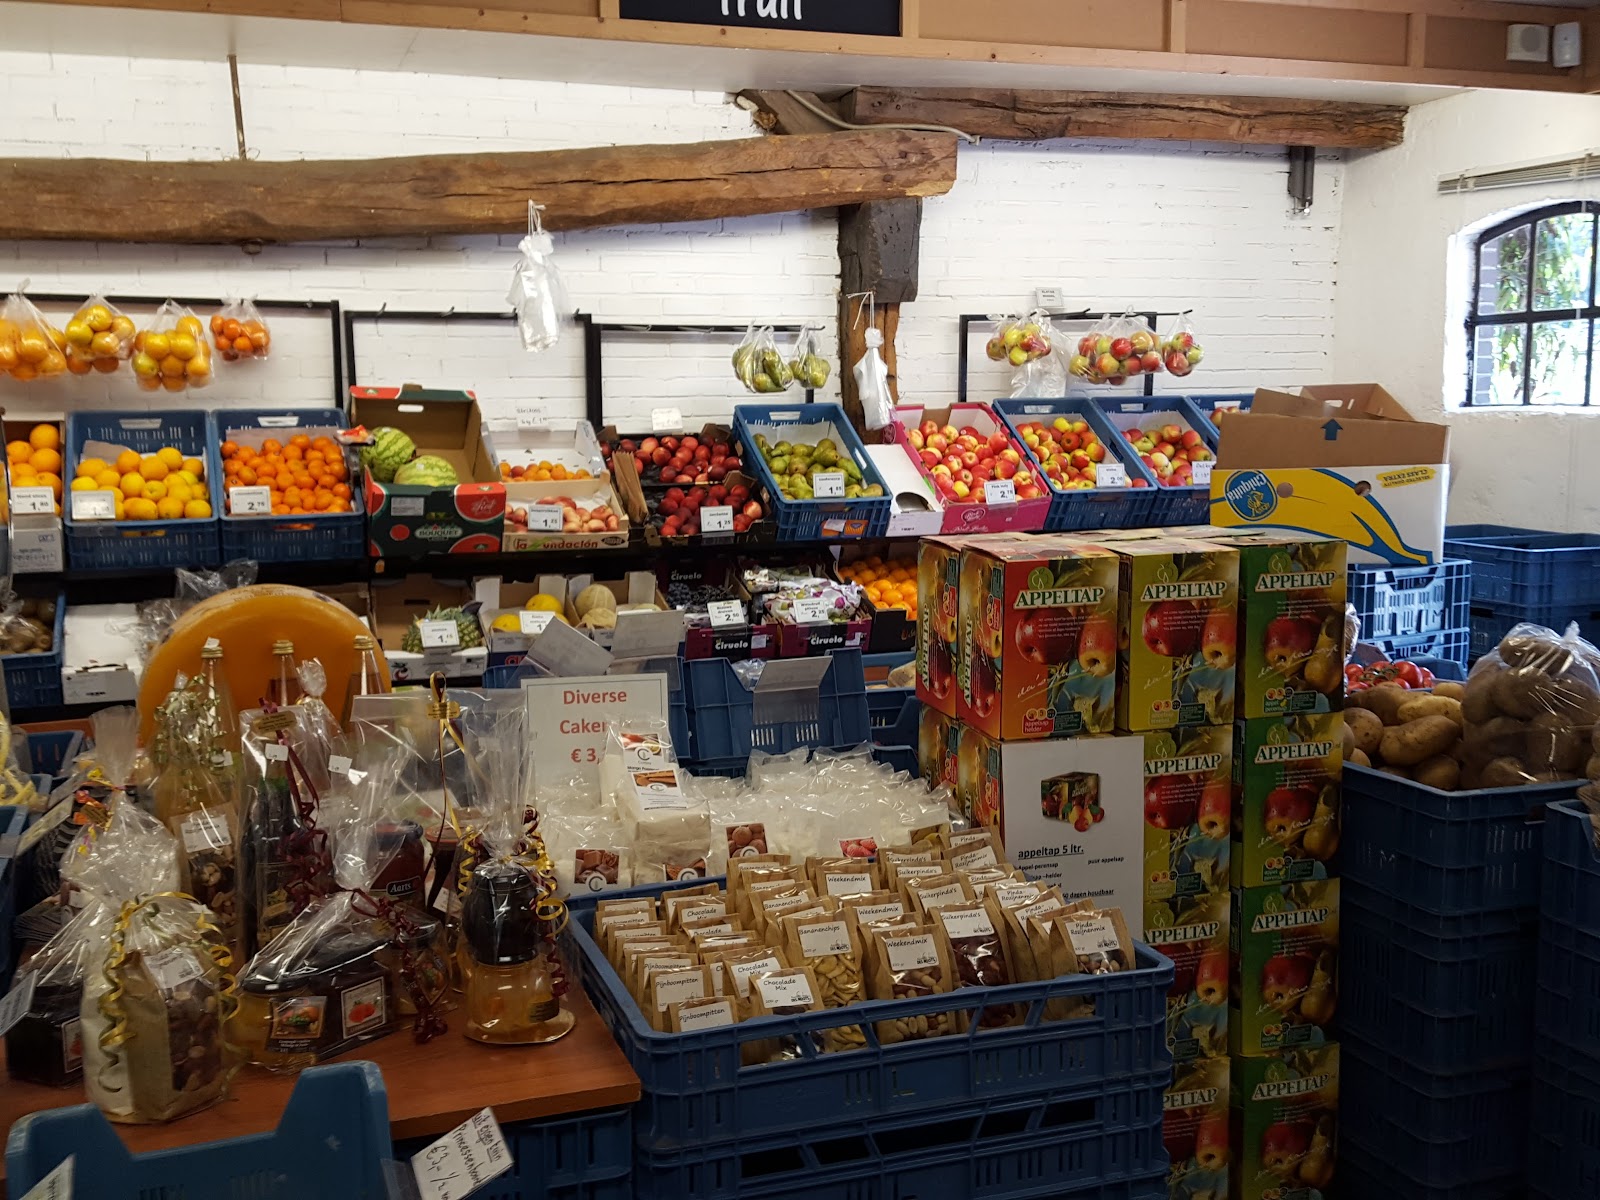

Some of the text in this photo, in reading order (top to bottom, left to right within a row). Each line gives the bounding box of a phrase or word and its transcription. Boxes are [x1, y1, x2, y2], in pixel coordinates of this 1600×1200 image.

[1383, 473, 1406, 482] EXTRA
[1227, 473, 1267, 501] Chiquita
[671, 571, 702, 581] Ciruelo
[1257, 572, 1336, 591] APPELTAP
[1142, 581, 1227, 601] APPELTAP
[1015, 588, 1104, 608] APPELTAP
[714, 639, 749, 651] Ciruelo
[810, 636, 844, 646] Ciruelo
[563, 689, 628, 704] Diverse
[571, 748, 582, 763] €
[1256, 742, 1333, 763] APPELTAP
[1143, 754, 1222, 775] APPELTAP
[1018, 844, 1085, 860] appeltap 5 ltr.
[1101, 856, 1124, 864] appelsap
[390, 883, 411, 893] Aarts
[919, 887, 957, 900] Suikerpinda's
[1087, 889, 1115, 898] houdbaar
[764, 899, 803, 909] Bananenchips
[686, 907, 717, 917] Chocolade
[859, 906, 899, 915] Weekendmix
[1253, 908, 1329, 931] APPELTAP
[799, 925, 840, 935] Bananenchips
[887, 937, 929, 948] Weekendmix
[738, 962, 769, 973] Chocolade
[655, 977, 699, 989] Pijnboompitten
[679, 1008, 725, 1022] Pijnboompitten
[1253, 1074, 1329, 1099] APPELTAP
[1163, 1088, 1218, 1109] PELTAP
